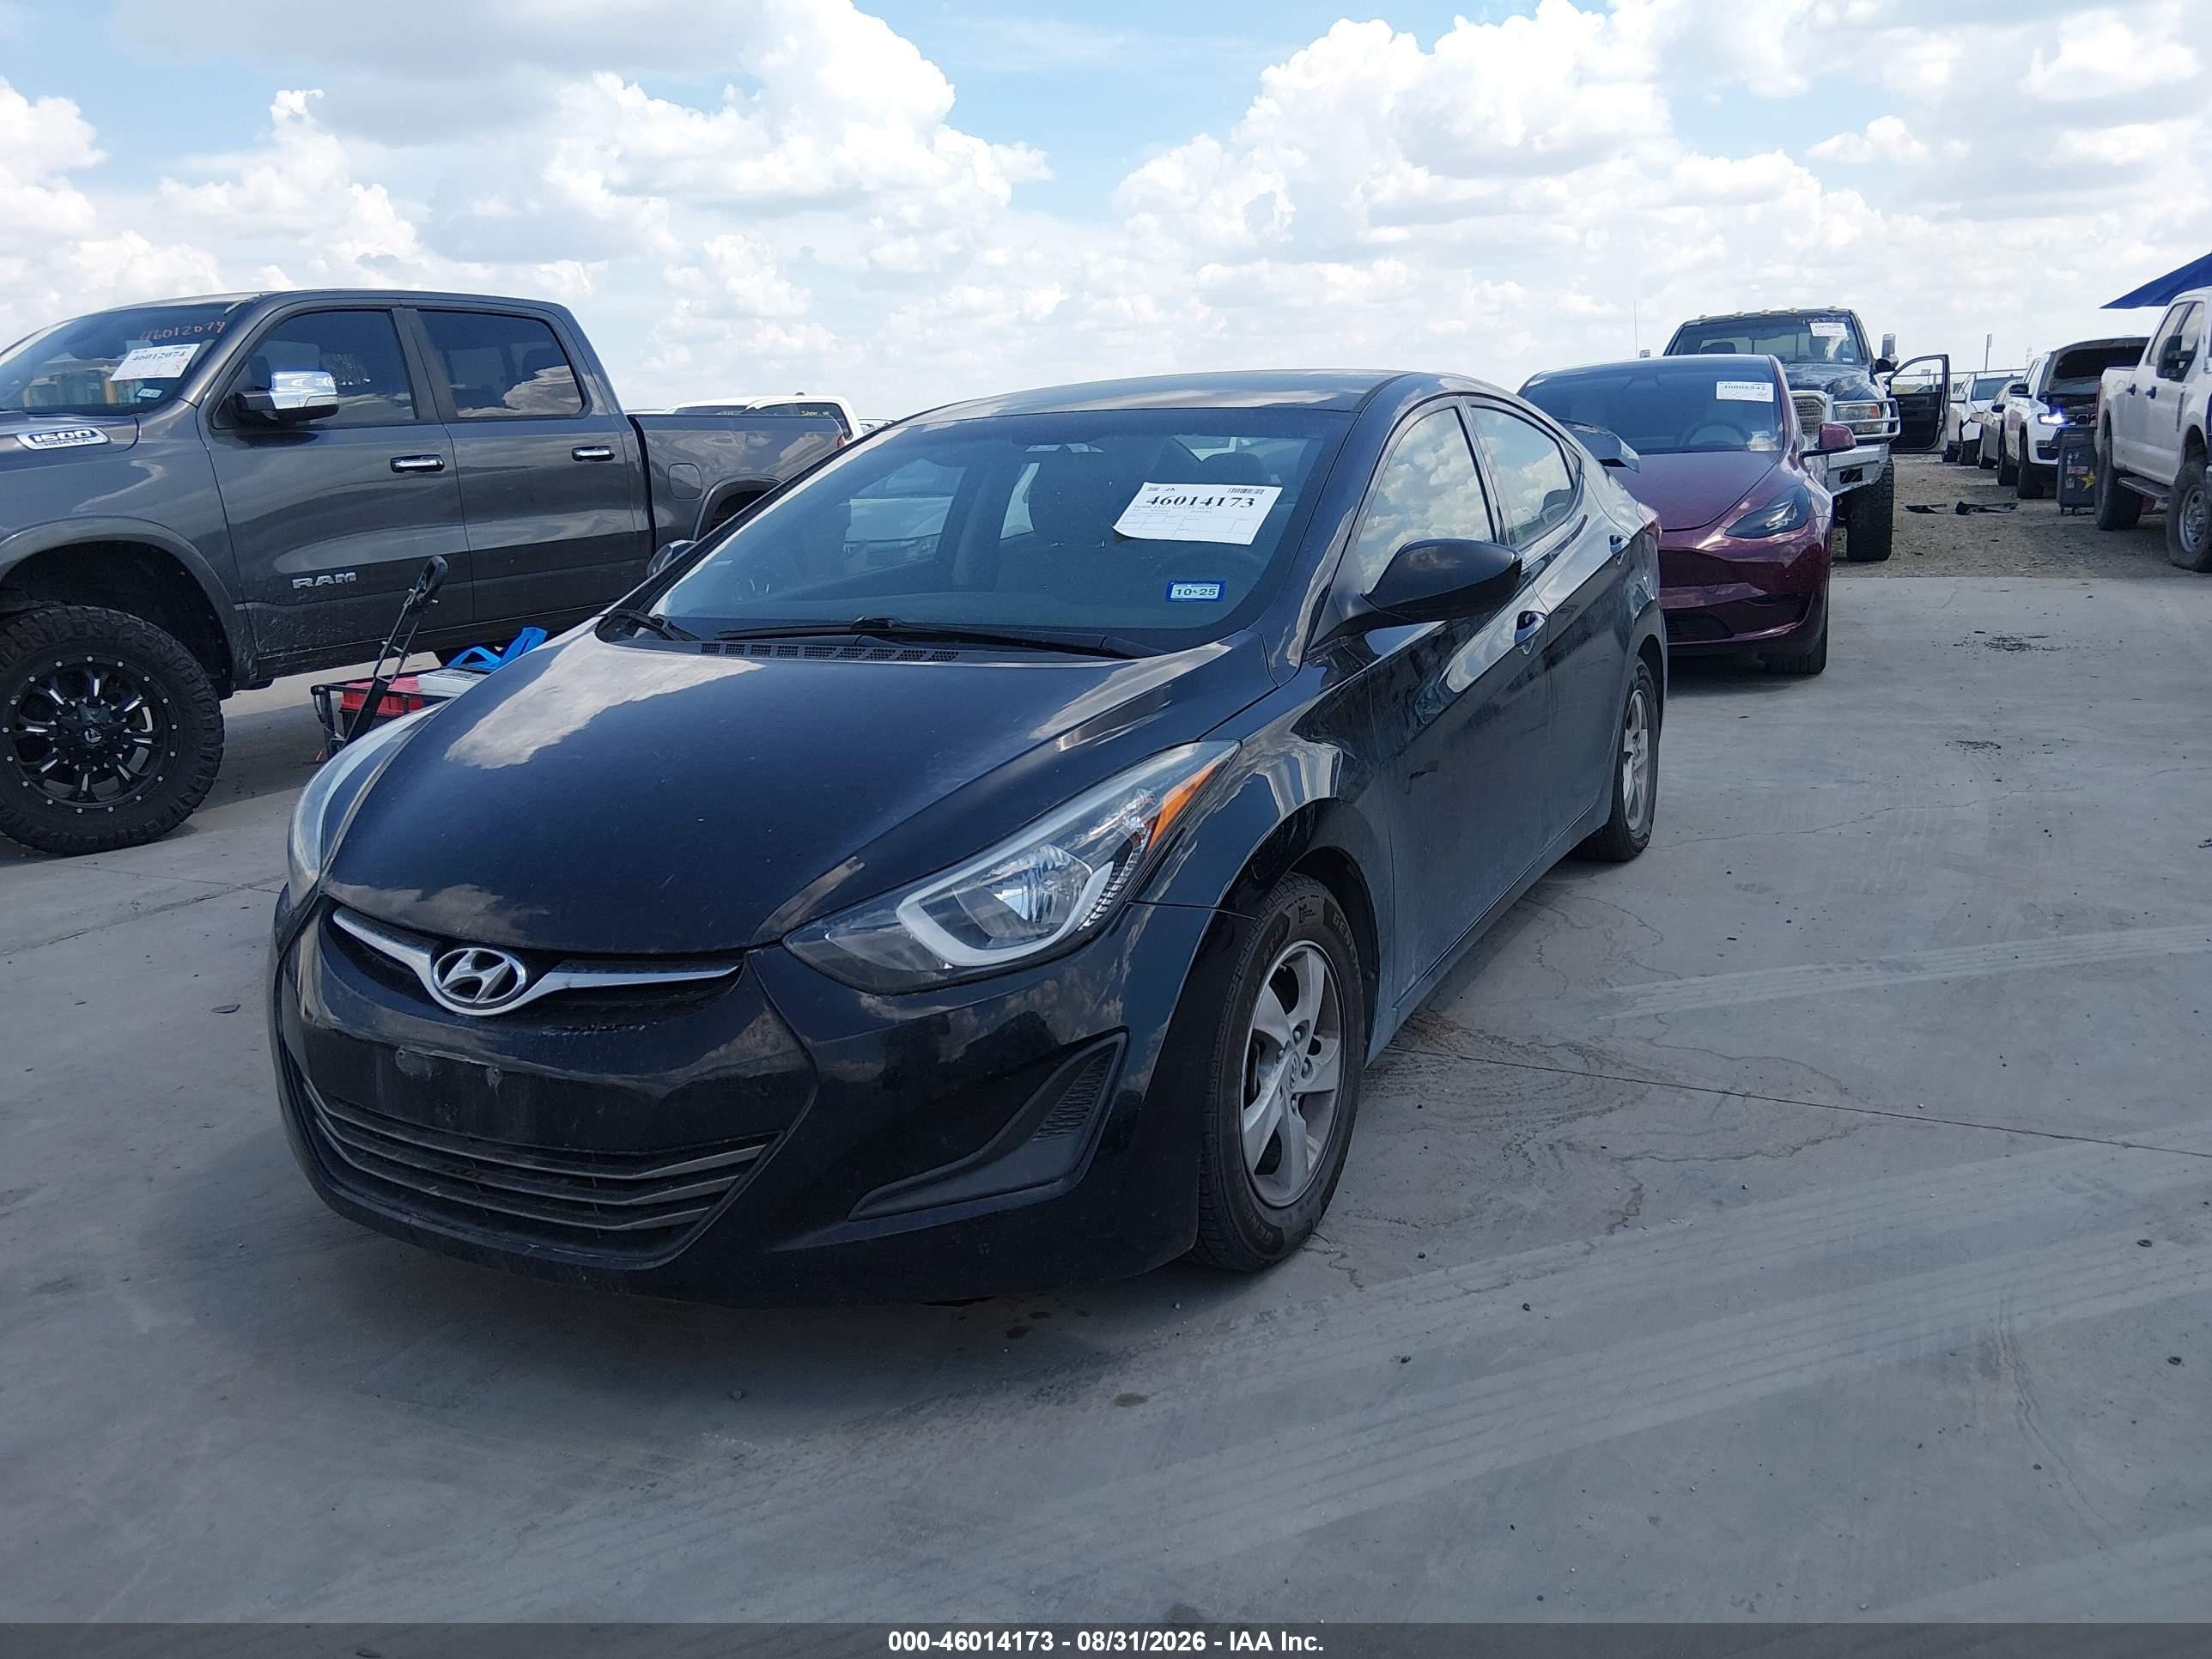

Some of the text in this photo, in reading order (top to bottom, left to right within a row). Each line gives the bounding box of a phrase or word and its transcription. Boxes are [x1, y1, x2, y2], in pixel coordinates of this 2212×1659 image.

[32, 429, 93, 443] 1500
[1145, 495, 1256, 508] 46014173
[291, 571, 357, 589] RAM
